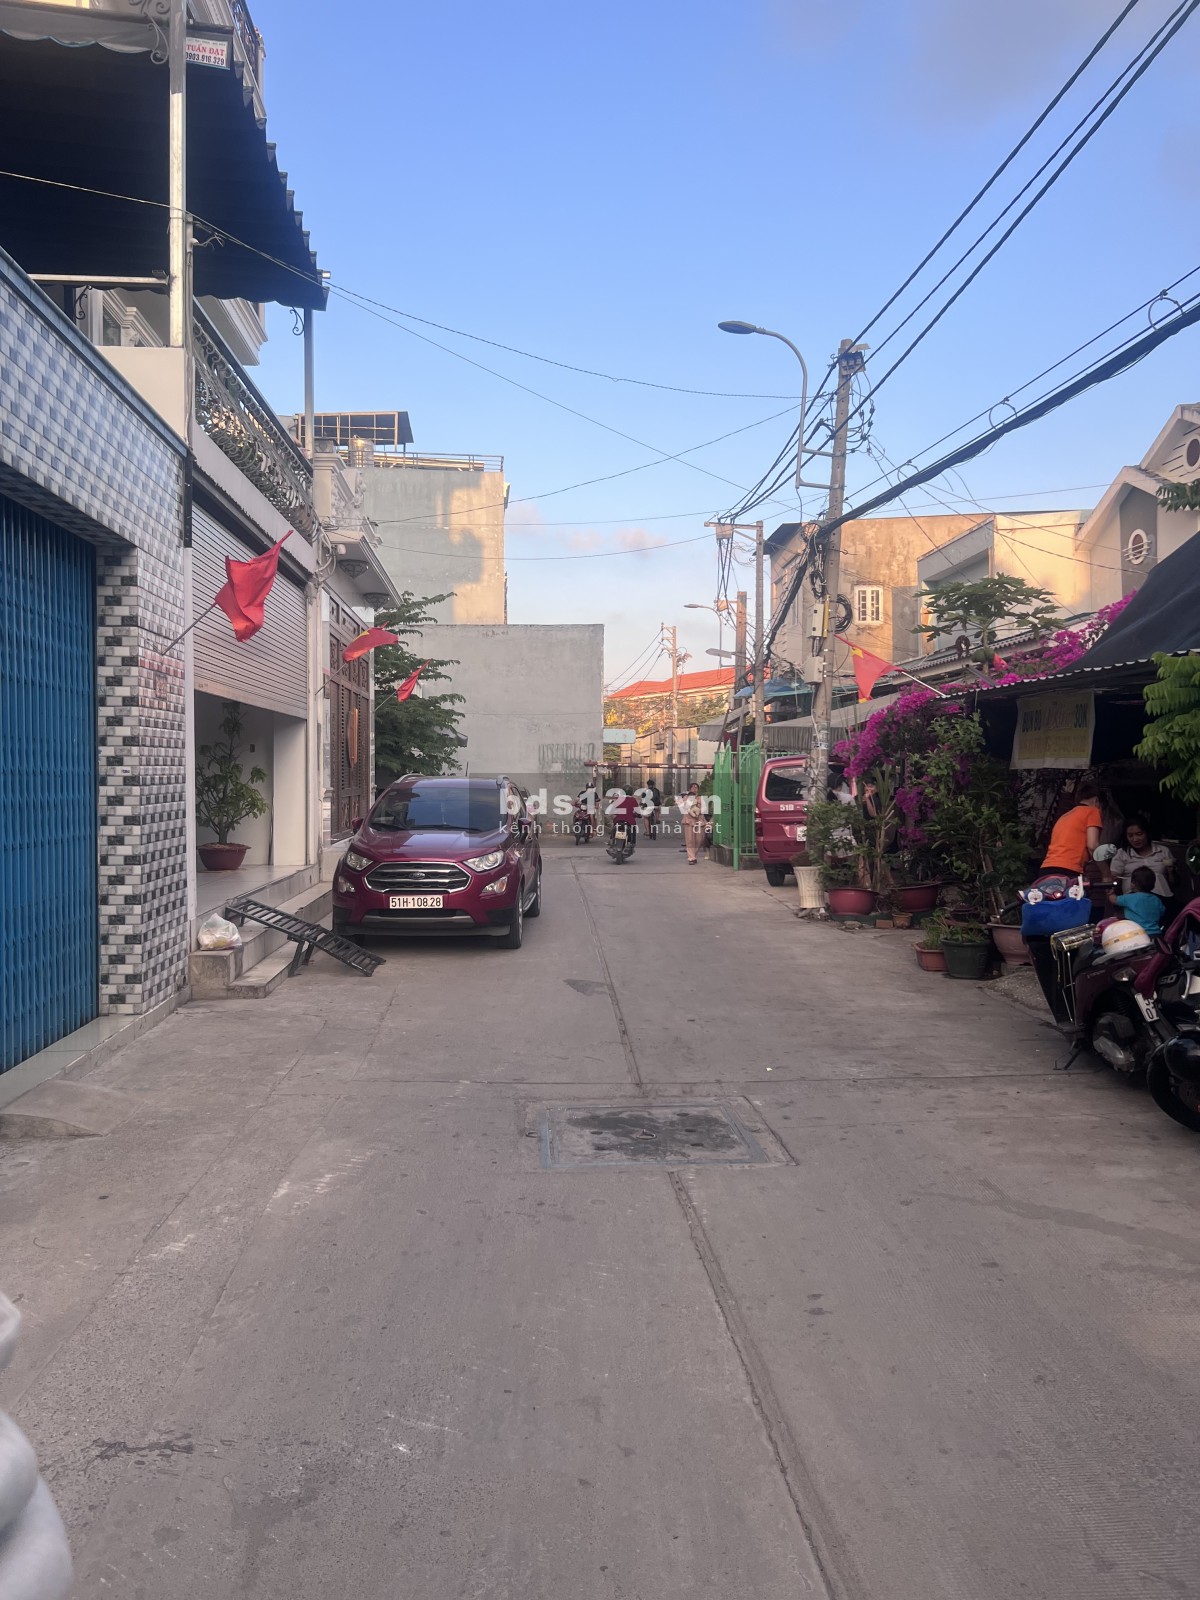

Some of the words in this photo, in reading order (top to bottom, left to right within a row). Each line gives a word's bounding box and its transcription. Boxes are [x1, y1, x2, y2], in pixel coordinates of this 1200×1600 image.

[187, 43, 206, 53] TUẤN
[208, 47, 225, 57] ĐẠT
[391, 897, 442, 908] 51H-108.28
